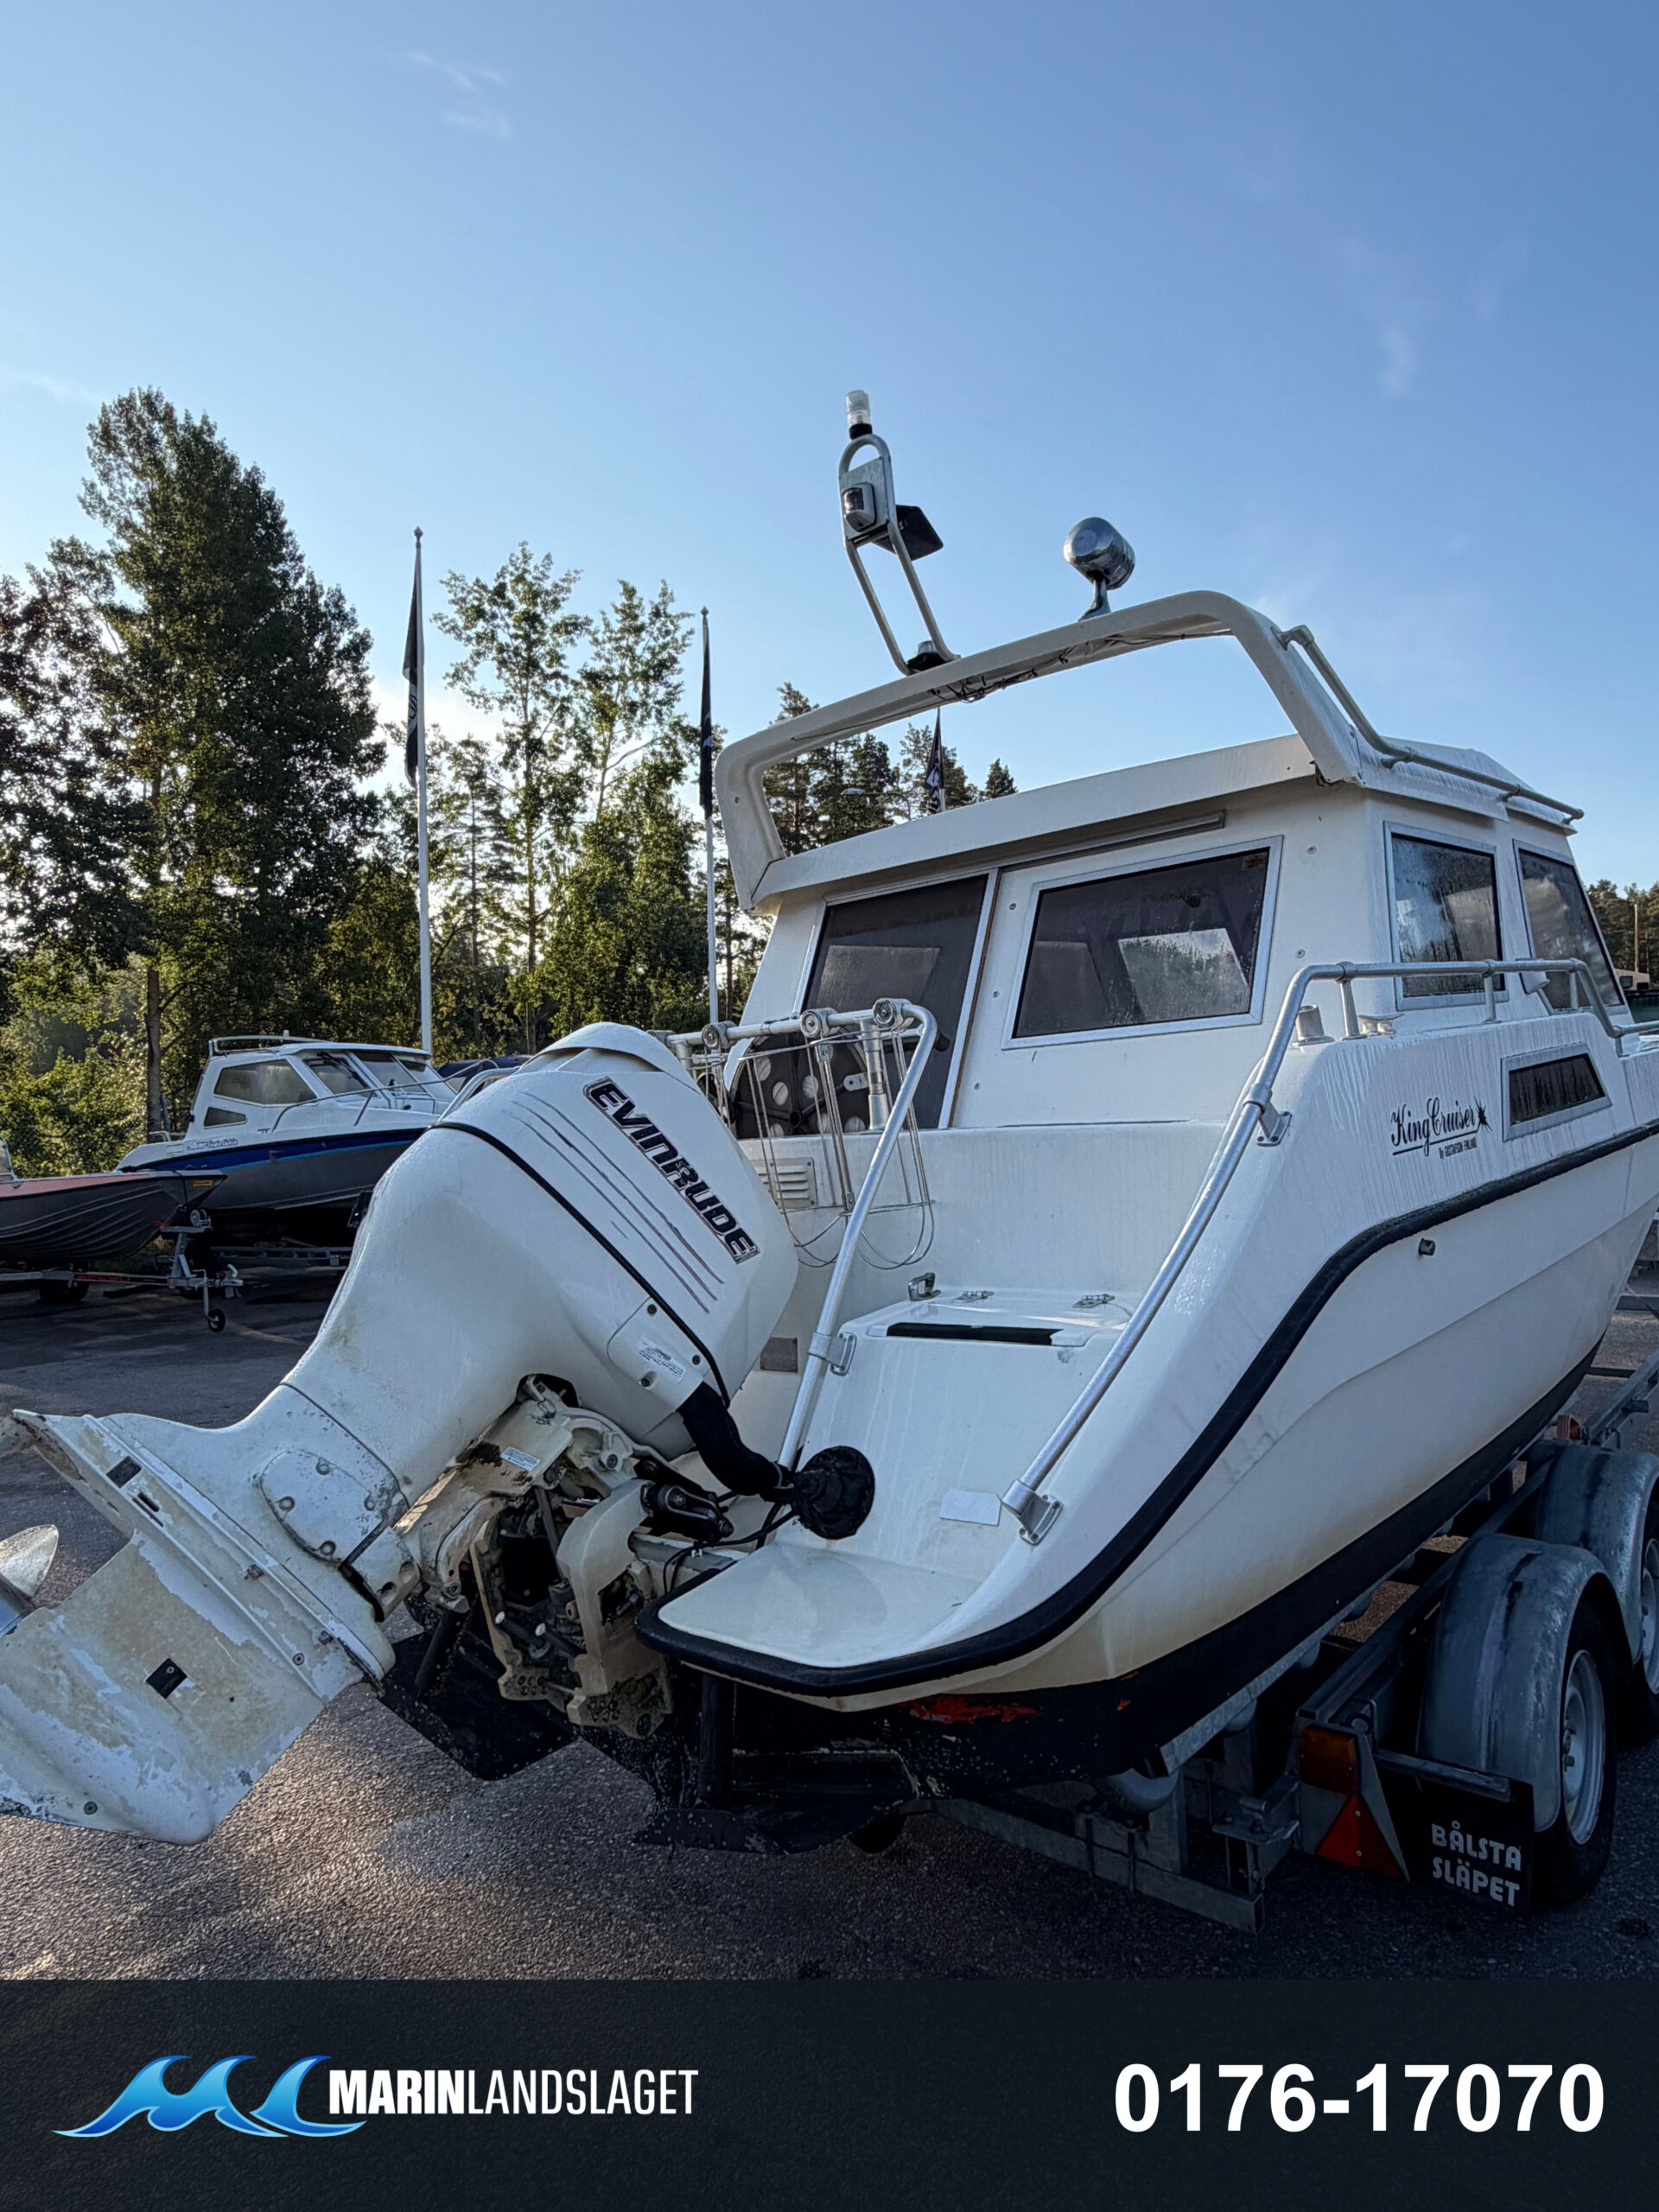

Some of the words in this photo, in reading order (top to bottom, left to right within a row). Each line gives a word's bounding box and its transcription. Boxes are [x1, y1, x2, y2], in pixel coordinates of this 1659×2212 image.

[583, 1077, 760, 1264] EVINRUDE
[1431, 1821, 1522, 1871] BÅLSTA
[1432, 1856, 1520, 1907] SLÄPET
